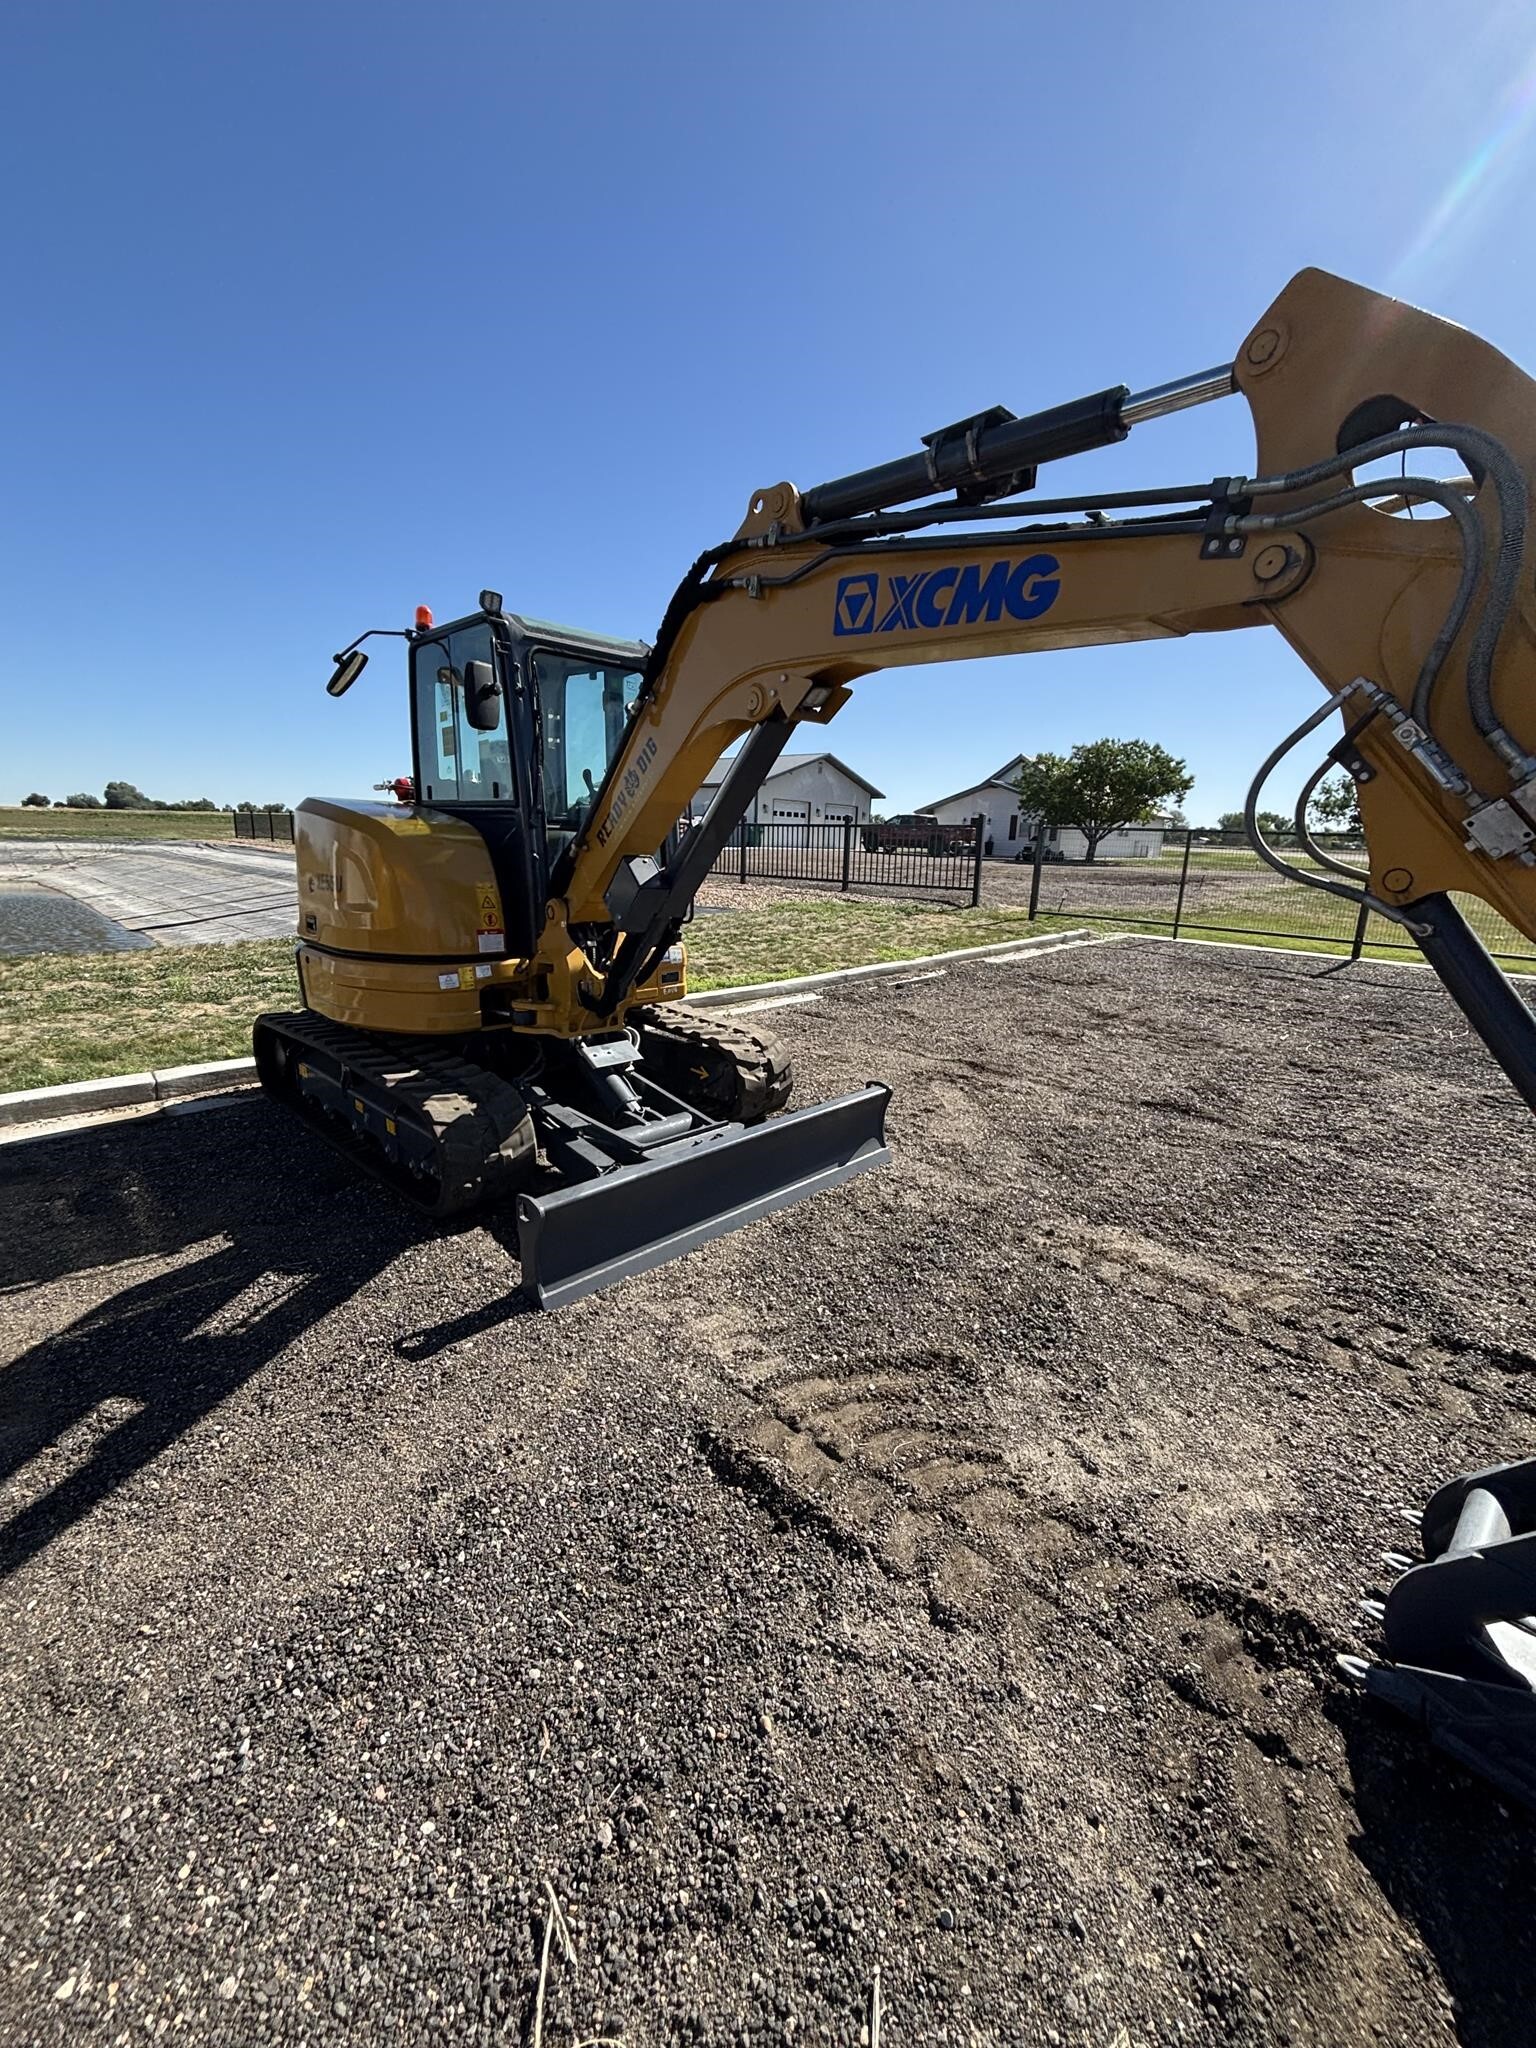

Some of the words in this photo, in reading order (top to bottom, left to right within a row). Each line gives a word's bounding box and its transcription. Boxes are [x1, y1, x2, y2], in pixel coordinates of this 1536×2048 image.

[874, 553, 1061, 632] XCMG
[596, 791, 627, 847] READY
[637, 737, 657, 774] DIG
